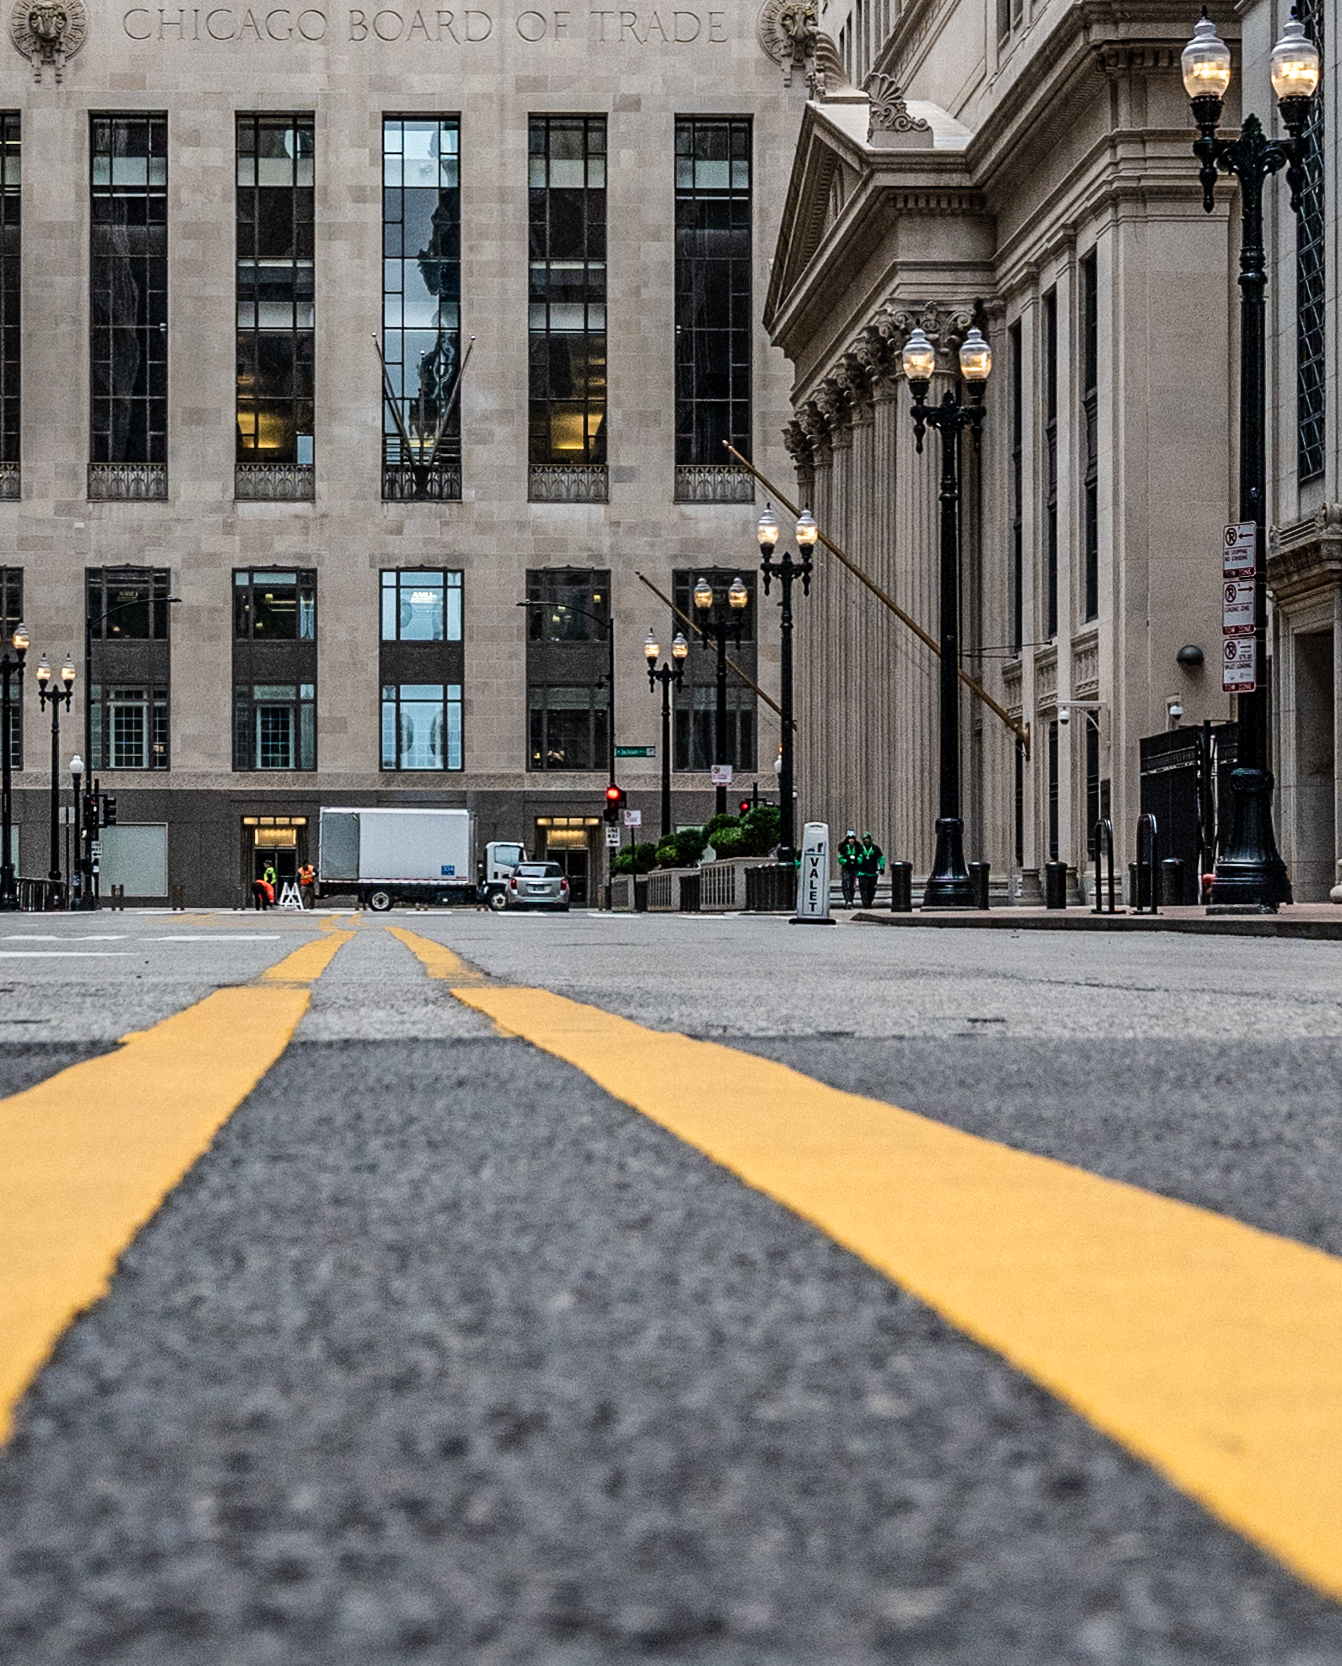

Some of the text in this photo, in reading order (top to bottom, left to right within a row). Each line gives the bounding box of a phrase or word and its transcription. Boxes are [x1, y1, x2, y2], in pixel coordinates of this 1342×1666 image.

[122, 8, 729, 45] CHICAGO BOARD OF TRADE
[808, 857, 820, 912] VALET
